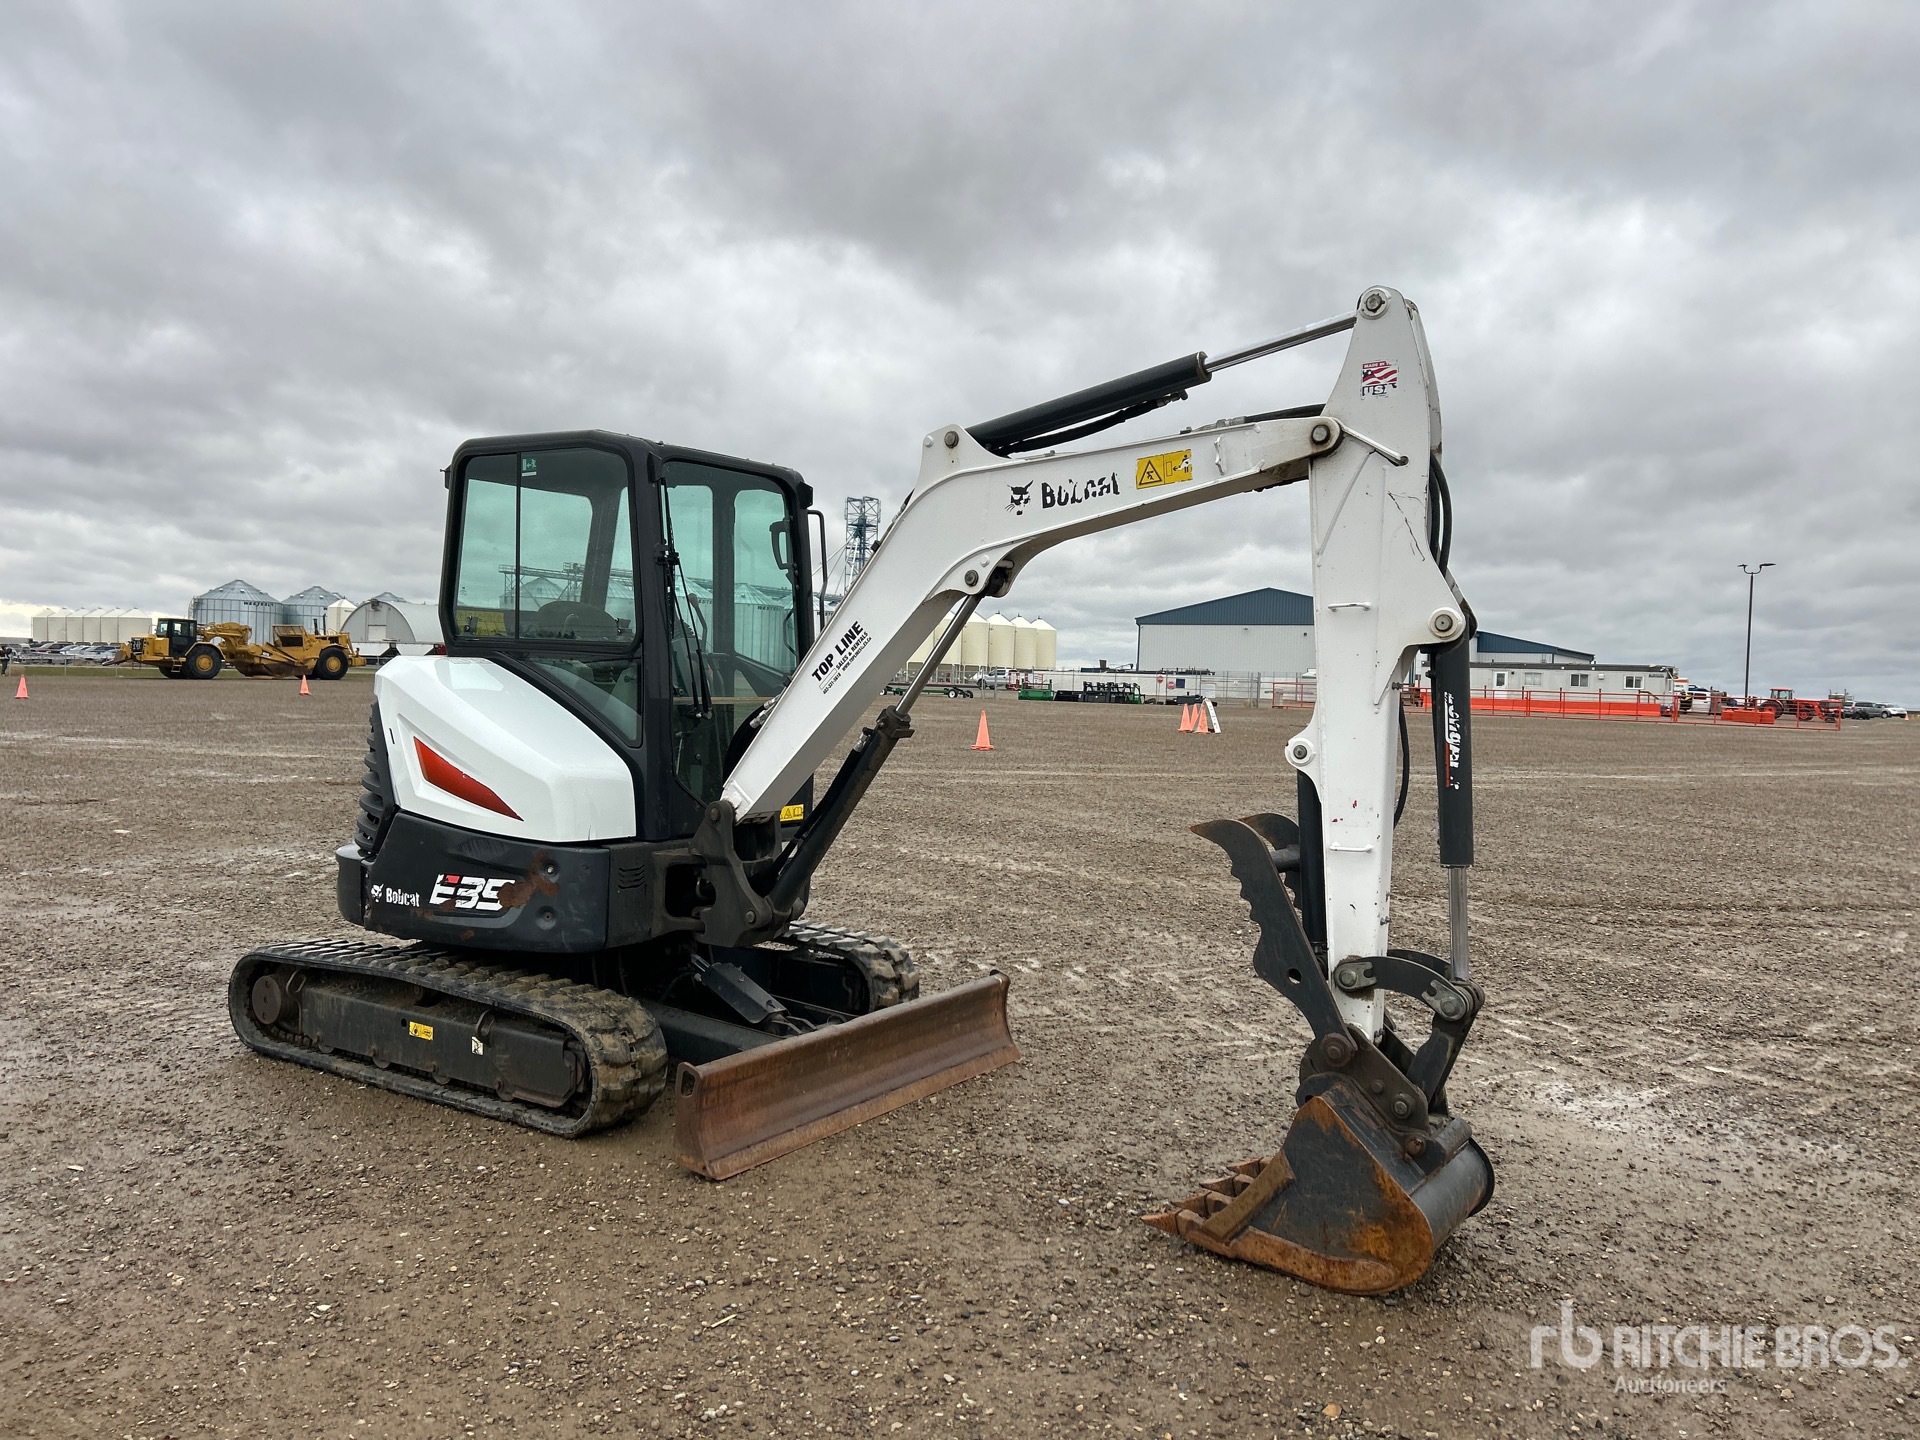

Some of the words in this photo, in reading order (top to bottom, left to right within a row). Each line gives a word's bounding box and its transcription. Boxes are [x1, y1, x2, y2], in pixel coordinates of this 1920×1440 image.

[812, 654, 833, 681] TOP
[835, 621, 863, 655] LINE
[836, 655, 848, 670] SALES
[386, 887, 420, 907] Bobcat
[429, 874, 516, 911] E35
